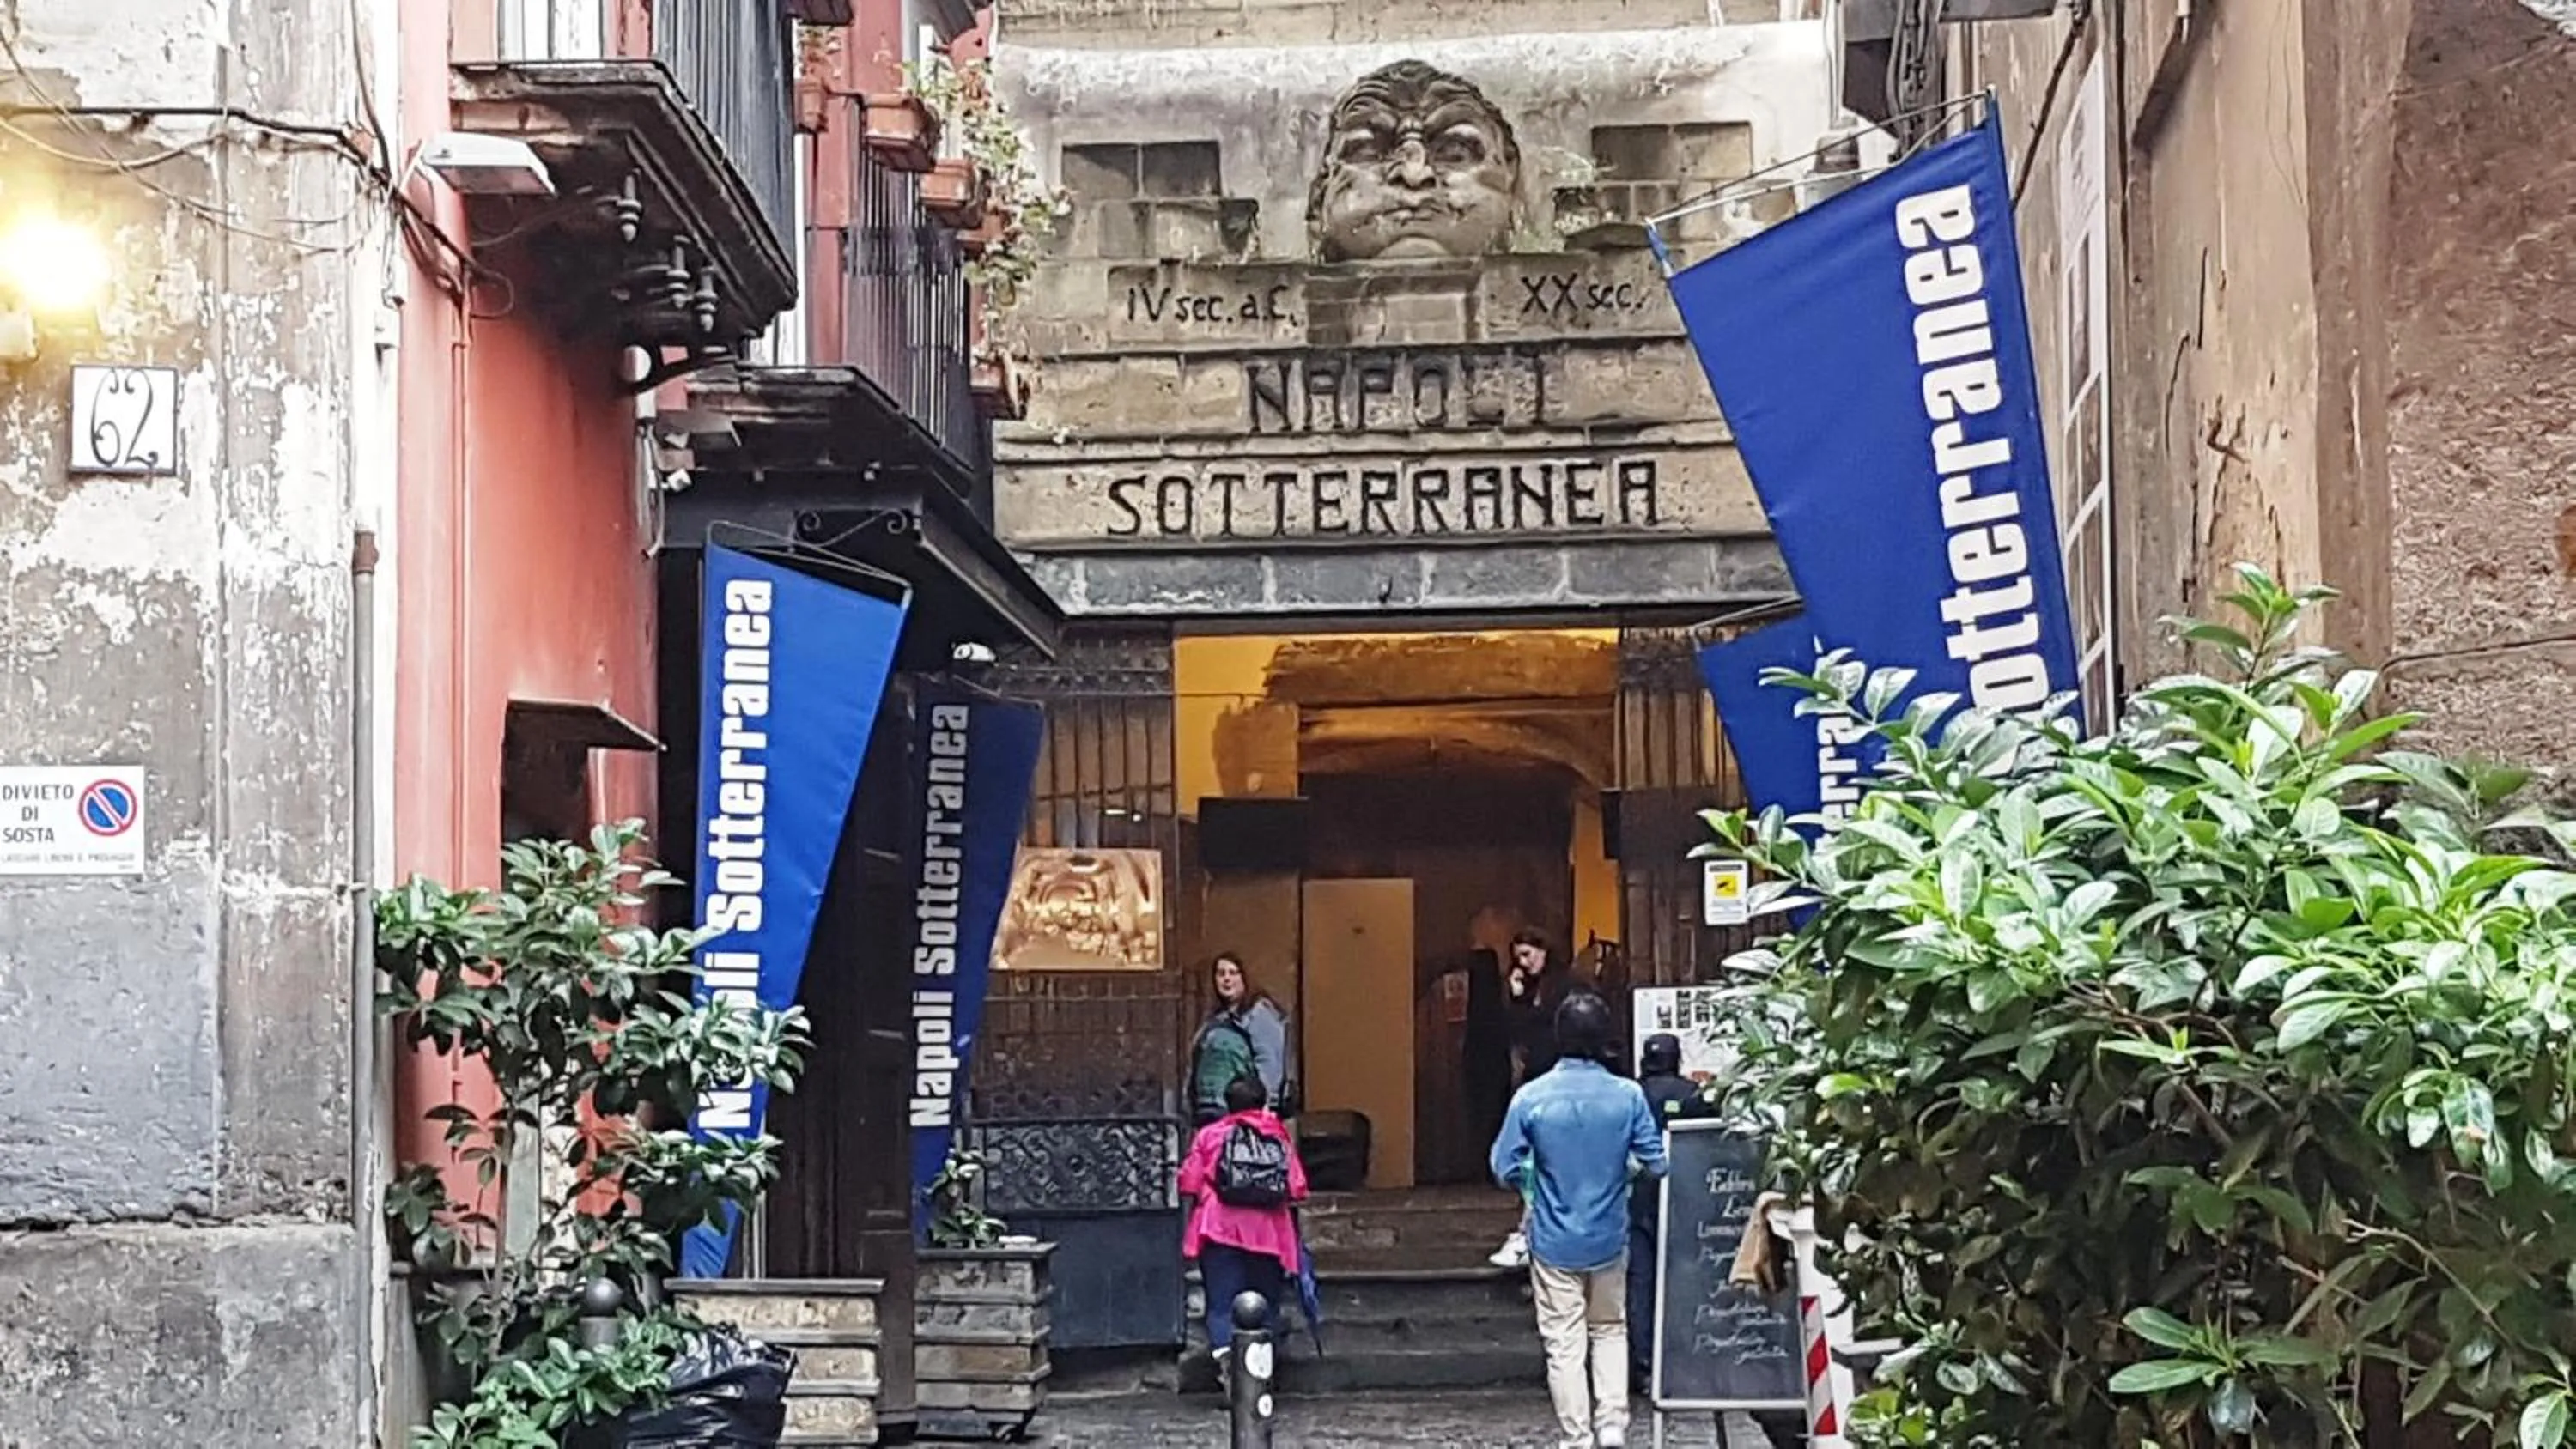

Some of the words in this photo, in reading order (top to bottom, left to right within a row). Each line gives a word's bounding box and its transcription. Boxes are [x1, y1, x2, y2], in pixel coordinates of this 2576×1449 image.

[1127, 288, 1171, 322] IV
[1521, 272, 1578, 318] XX
[90, 367, 159, 468] 62
[1247, 355, 1546, 433] NAPOLI
[1107, 460, 1658, 537] SOTTERRANEA
[1895, 184, 2050, 773] otterranea
[2, 785, 74, 800] DIVIETO
[706, 577, 774, 931] Sotterranea
[3, 827, 54, 842] SOSTA
[21, 806, 39, 821] DI
[914, 704, 969, 977] Sotterranea
[909, 991, 954, 1127] Napoli
